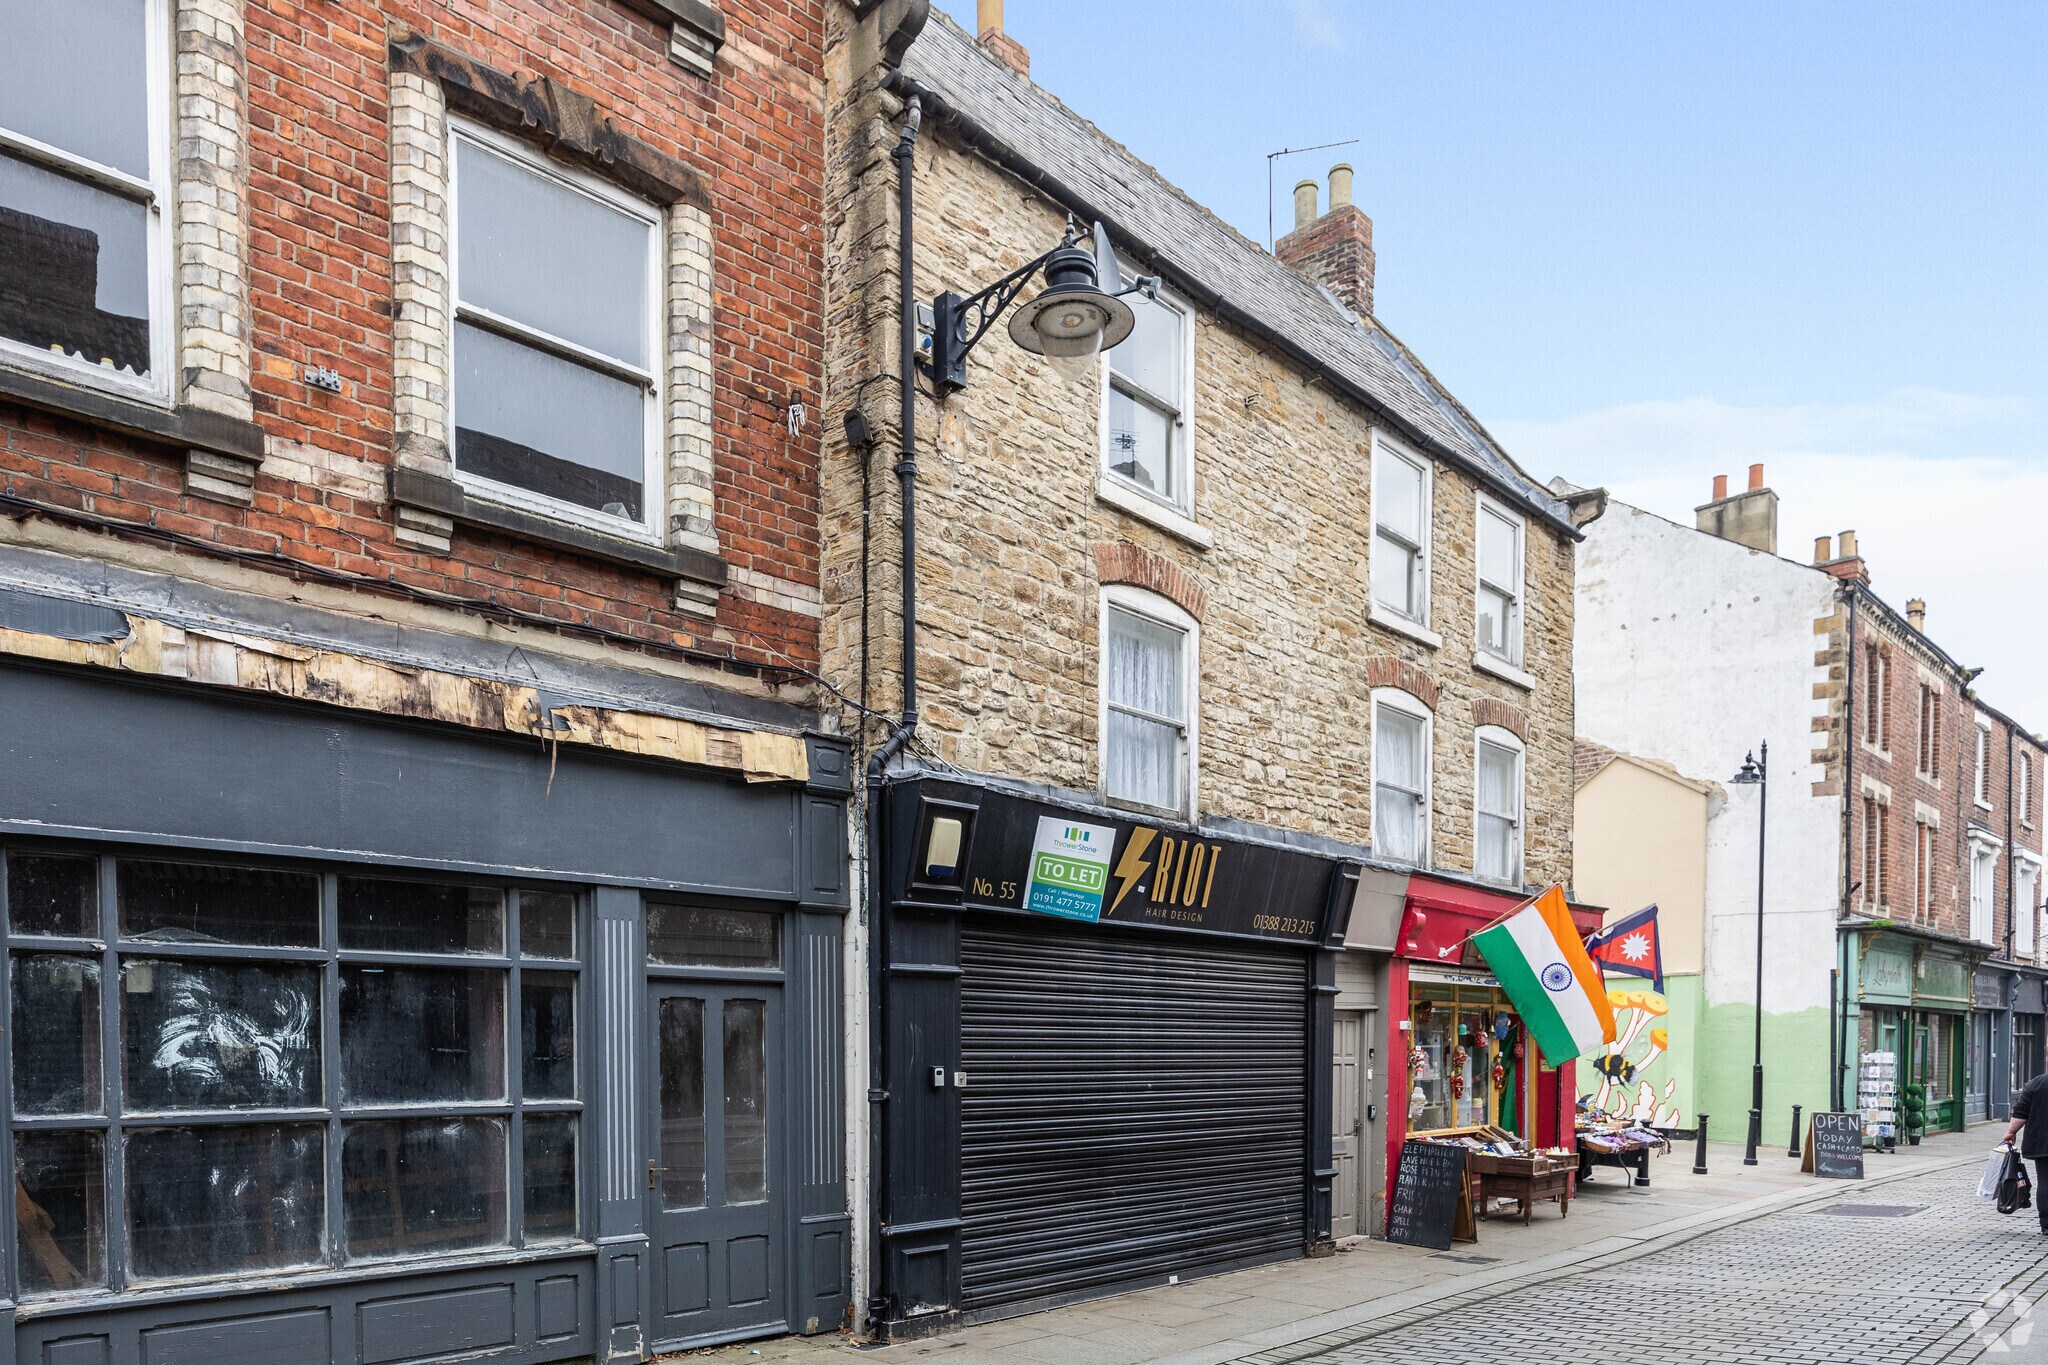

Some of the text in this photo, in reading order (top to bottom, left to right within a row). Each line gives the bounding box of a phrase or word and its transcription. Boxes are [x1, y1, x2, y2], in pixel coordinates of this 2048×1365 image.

[1053, 839, 1097, 854] ThrowerStone
[1043, 861, 1099, 885] TO LET
[1151, 836, 1222, 908] RIOT
[972, 877, 1017, 900] No. 55
[1047, 887, 1057, 895] Call
[1061, 890, 1085, 901] WhatsApp
[1032, 902, 1094, 919] www.throwerstone.co.uk
[1033, 892, 1096, 912] 0191 477 5777
[1145, 907, 1204, 923] HAIR DESIGN
[1253, 914, 1316, 935] 01388 213 215
[1815, 1114, 1859, 1131] OPEN
[1816, 1131, 1853, 1144] TODAY
[1400, 1164, 1418, 1175] ROSE
